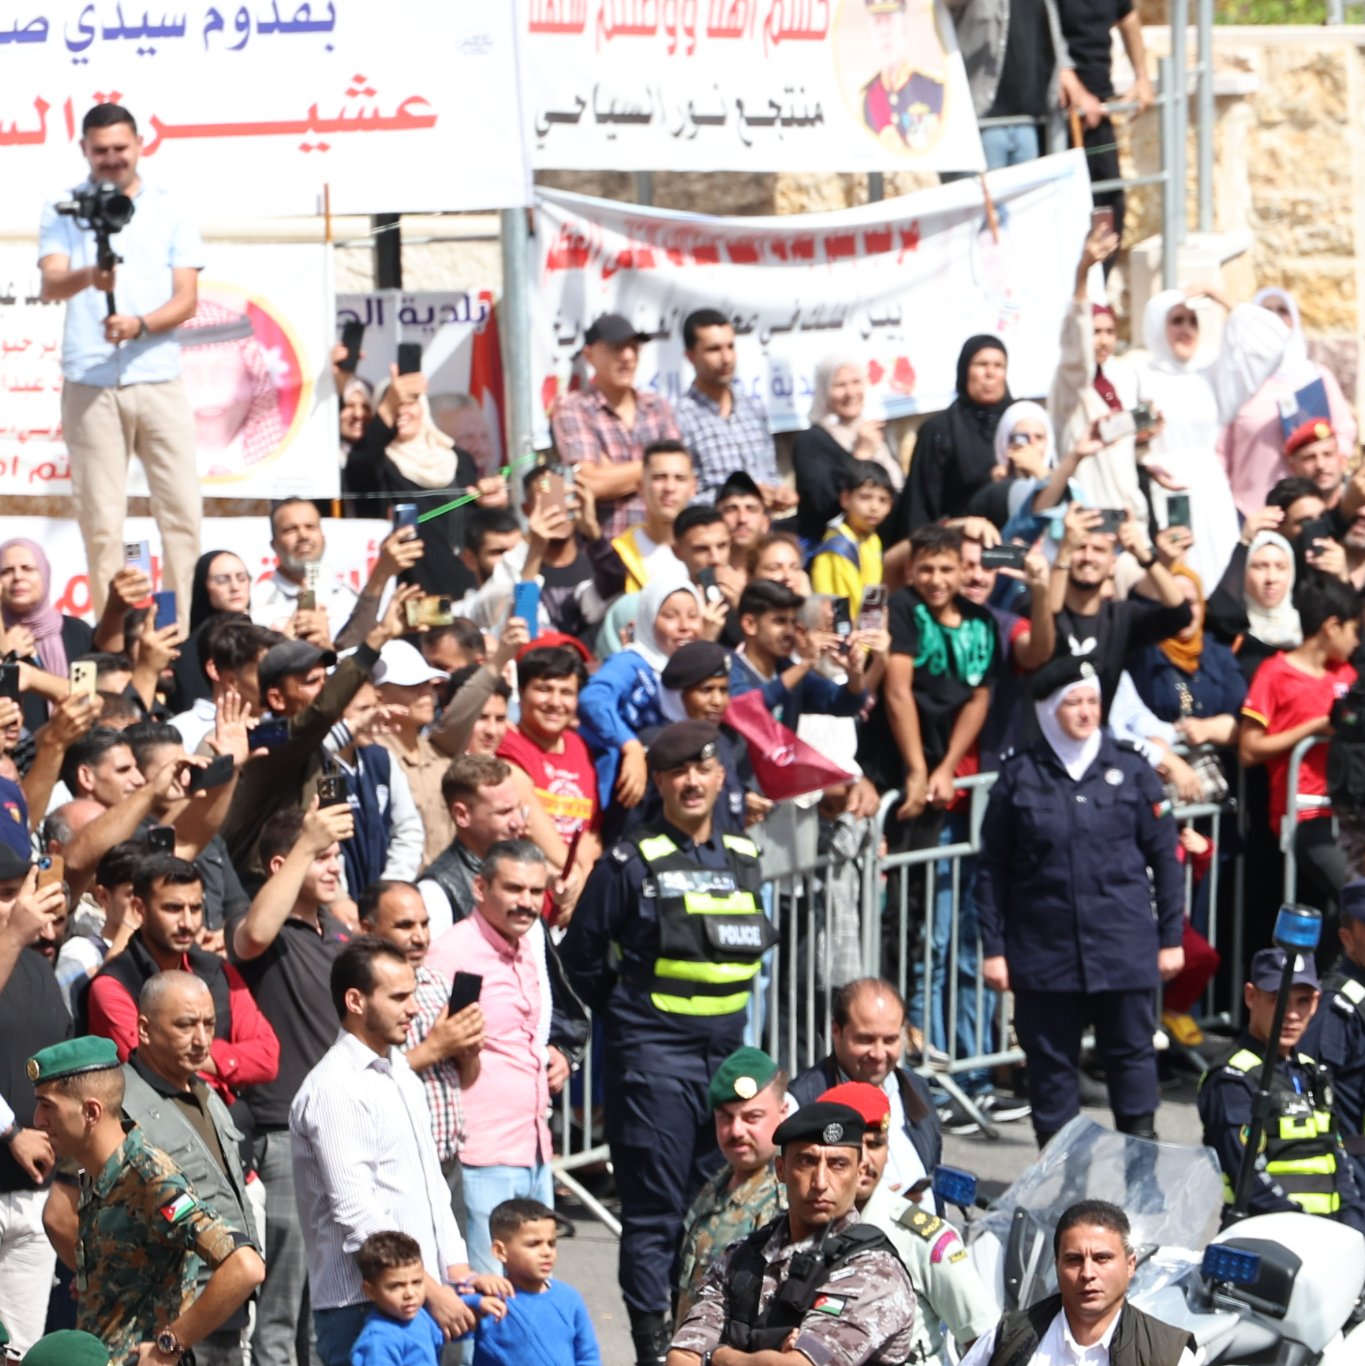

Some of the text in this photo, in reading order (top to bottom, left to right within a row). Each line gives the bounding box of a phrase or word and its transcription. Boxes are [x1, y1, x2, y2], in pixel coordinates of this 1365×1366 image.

[64, 2, 187, 65] سيدي
[535, 80, 666, 150] السياحي
[735, 85, 825, 148] منتجع
[398, 295, 489, 334] بلدية
[718, 924, 762, 946] POLICE
